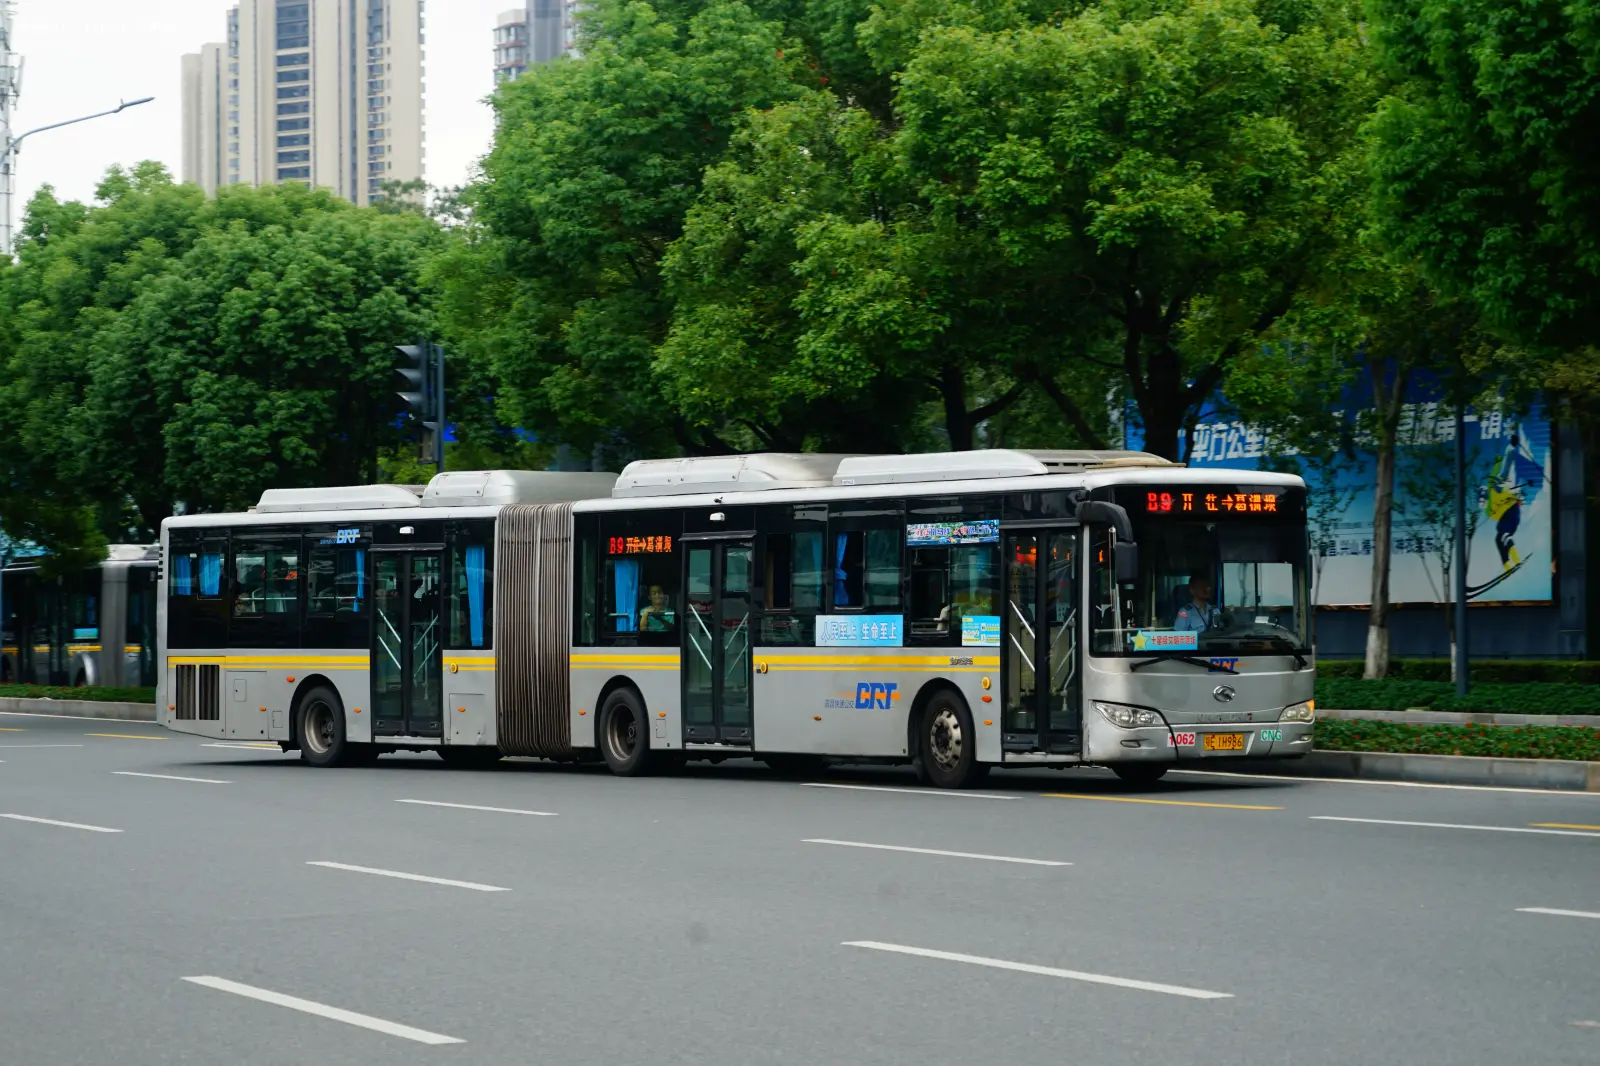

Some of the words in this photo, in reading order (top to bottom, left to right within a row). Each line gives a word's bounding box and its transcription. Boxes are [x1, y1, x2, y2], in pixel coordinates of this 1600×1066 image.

[1147, 493, 1172, 511] B9
[609, 537, 624, 555] B9
[821, 621, 857, 642] 人民至上
[861, 621, 897, 641] 生命至上
[855, 682, 897, 710] BRT
[1261, 730, 1281, 740] CNG
